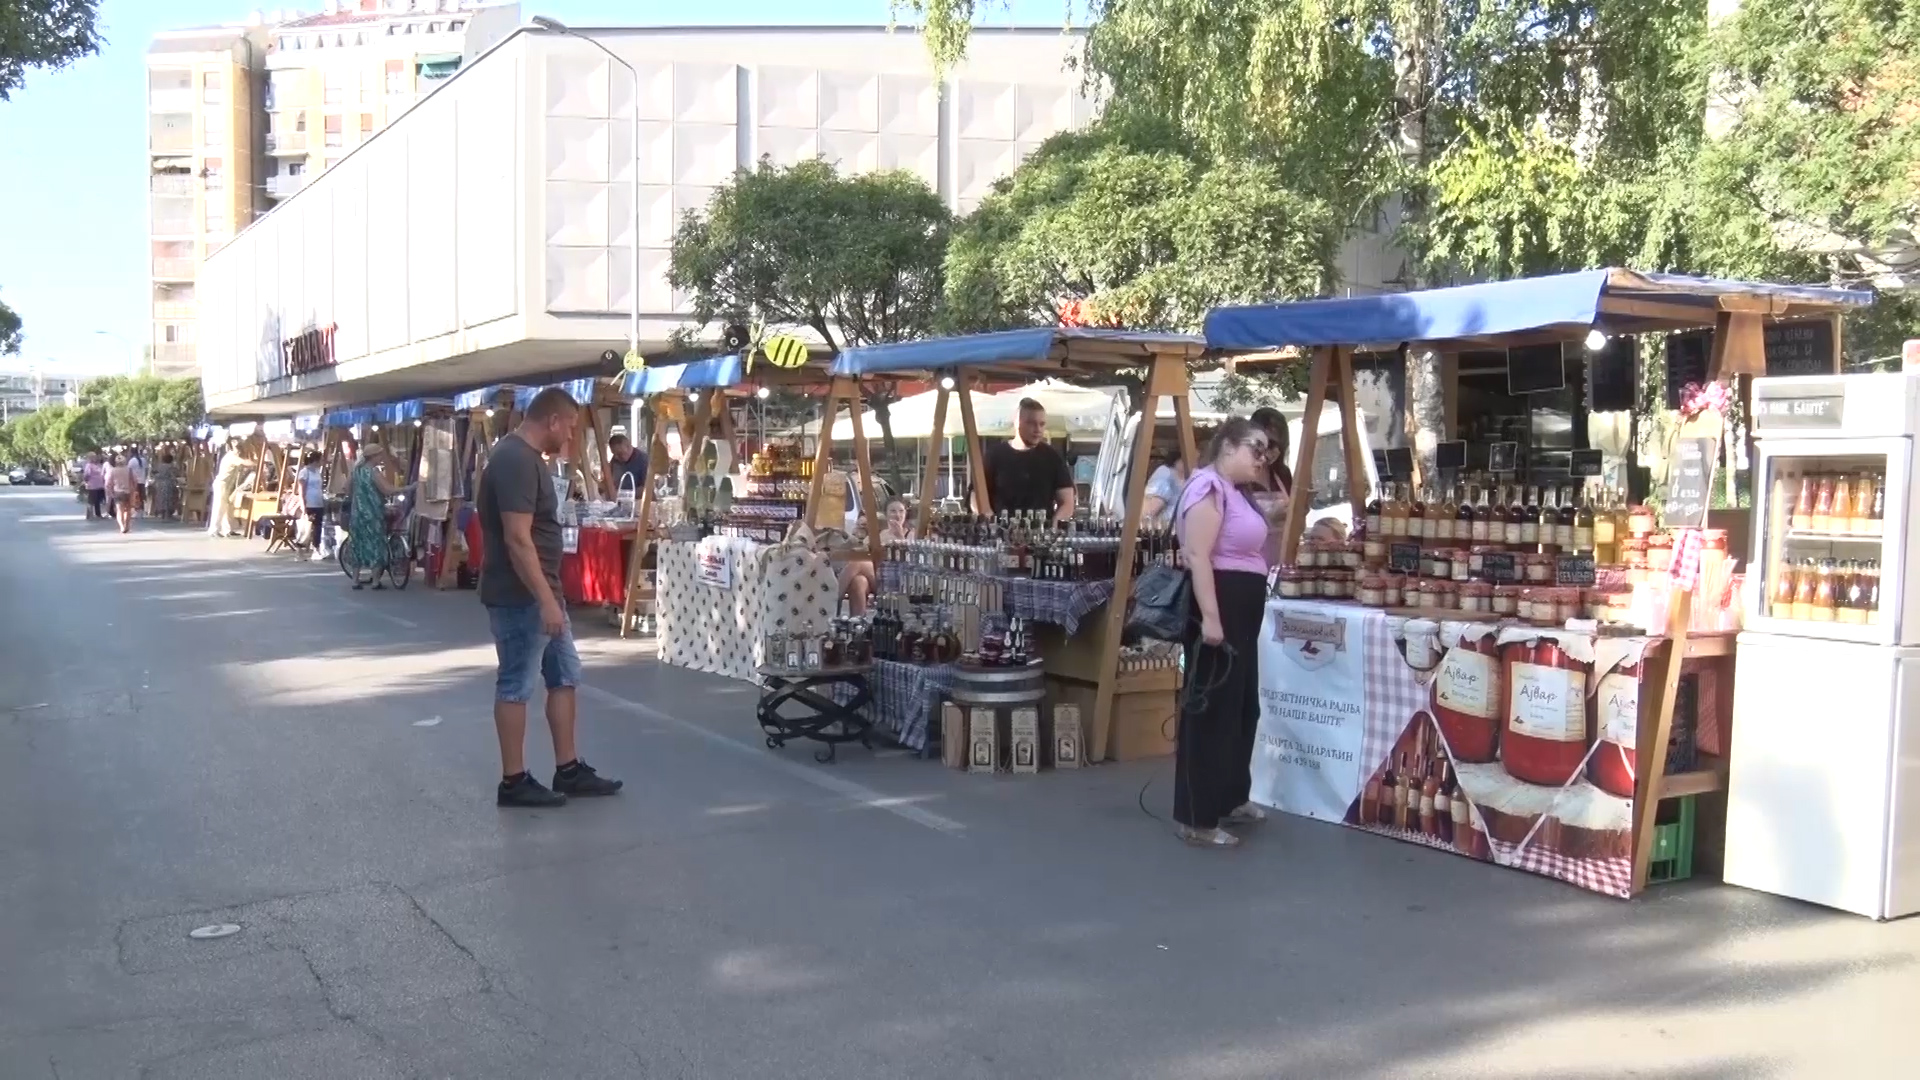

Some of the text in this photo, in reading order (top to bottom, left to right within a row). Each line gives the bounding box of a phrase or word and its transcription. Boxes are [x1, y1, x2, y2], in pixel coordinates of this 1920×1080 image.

[1443, 665, 1479, 686] Ајвар
[1519, 684, 1557, 704] Ајвар
[1307, 744, 1353, 762] ПАРАЋИН
